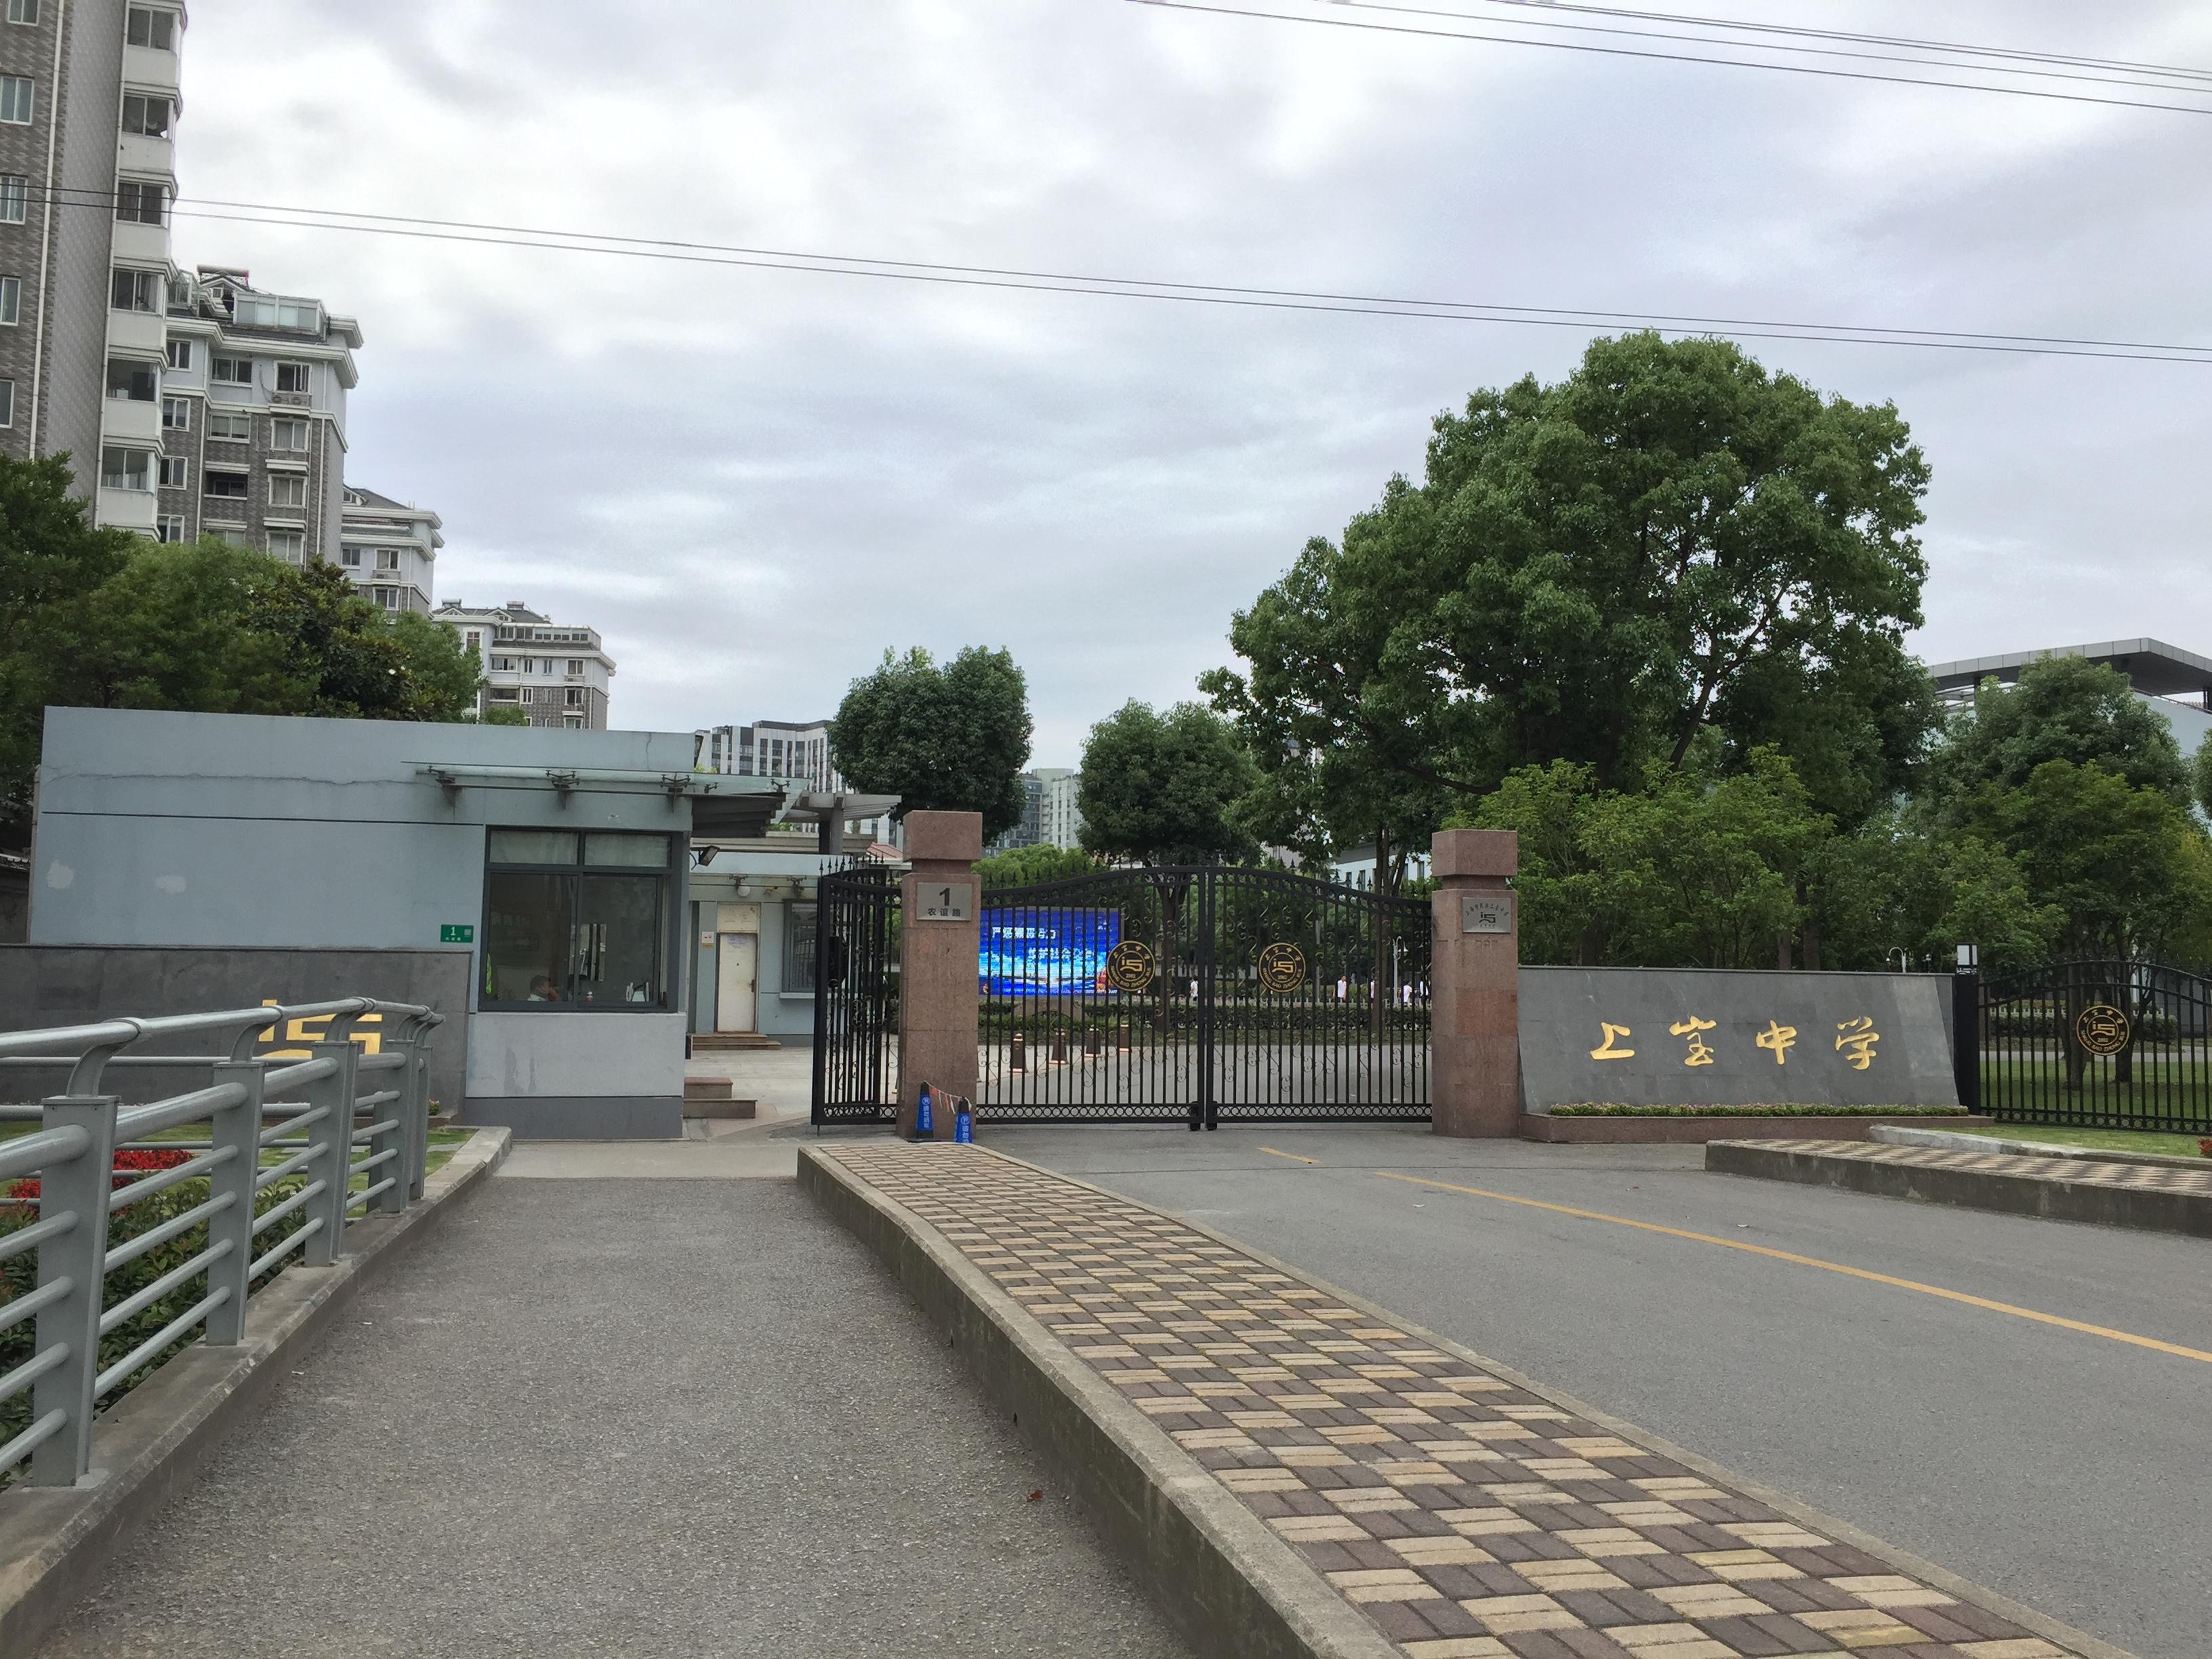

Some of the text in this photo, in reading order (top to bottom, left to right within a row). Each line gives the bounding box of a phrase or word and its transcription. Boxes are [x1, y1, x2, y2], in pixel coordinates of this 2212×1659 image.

[939, 888, 950, 906] 1
[928, 908, 961, 916] 农谊路
[450, 926, 456, 936] 1
[1590, 1015, 1880, 1069] 上宝中学
